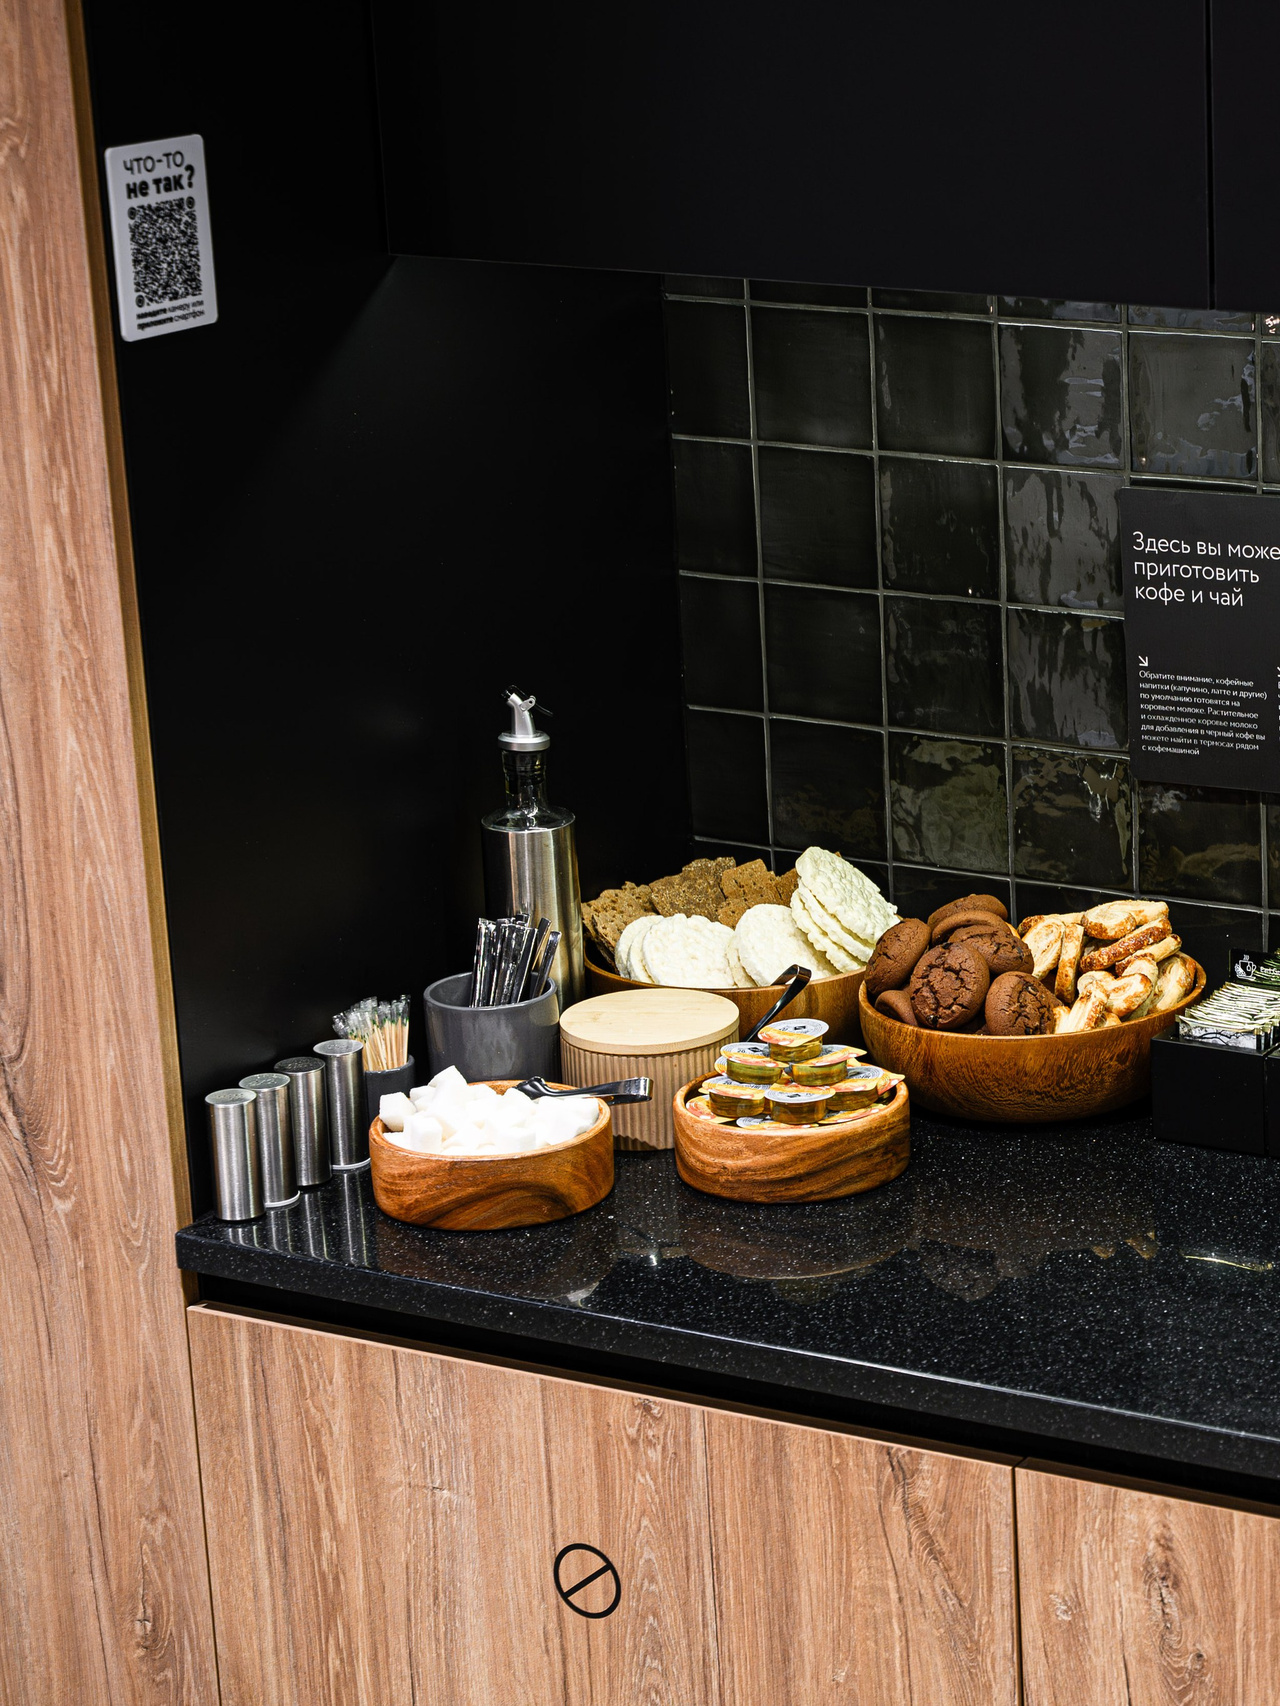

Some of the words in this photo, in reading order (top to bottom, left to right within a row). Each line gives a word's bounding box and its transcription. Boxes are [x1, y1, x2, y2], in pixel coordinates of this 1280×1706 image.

[125, 180, 149, 199] не
[152, 164, 195, 194] так?
[1133, 531, 1190, 554] Здесь
[1197, 541, 1221, 556] вы
[1134, 562, 1259, 583] приготовить
[1136, 582, 1185, 605] кофе
[1192, 590, 1203, 603] и
[1210, 588, 1243, 606] чай
[1139, 670, 1175, 680] Обратите
[1216, 678, 1254, 687] кофейные
[1151, 694, 1192, 702] умолчанию
[1194, 698, 1230, 706] готовятся
[1239, 691, 1267, 700] другие)
[1147, 714, 1196, 724] охлажденное
[1208, 707, 1258, 719] Растительное
[1155, 724, 1199, 734] добавления
[1235, 732, 1254, 740] кофе
[1148, 745, 1199, 755] кофемашиной
[1200, 740, 1234, 748] термосах
